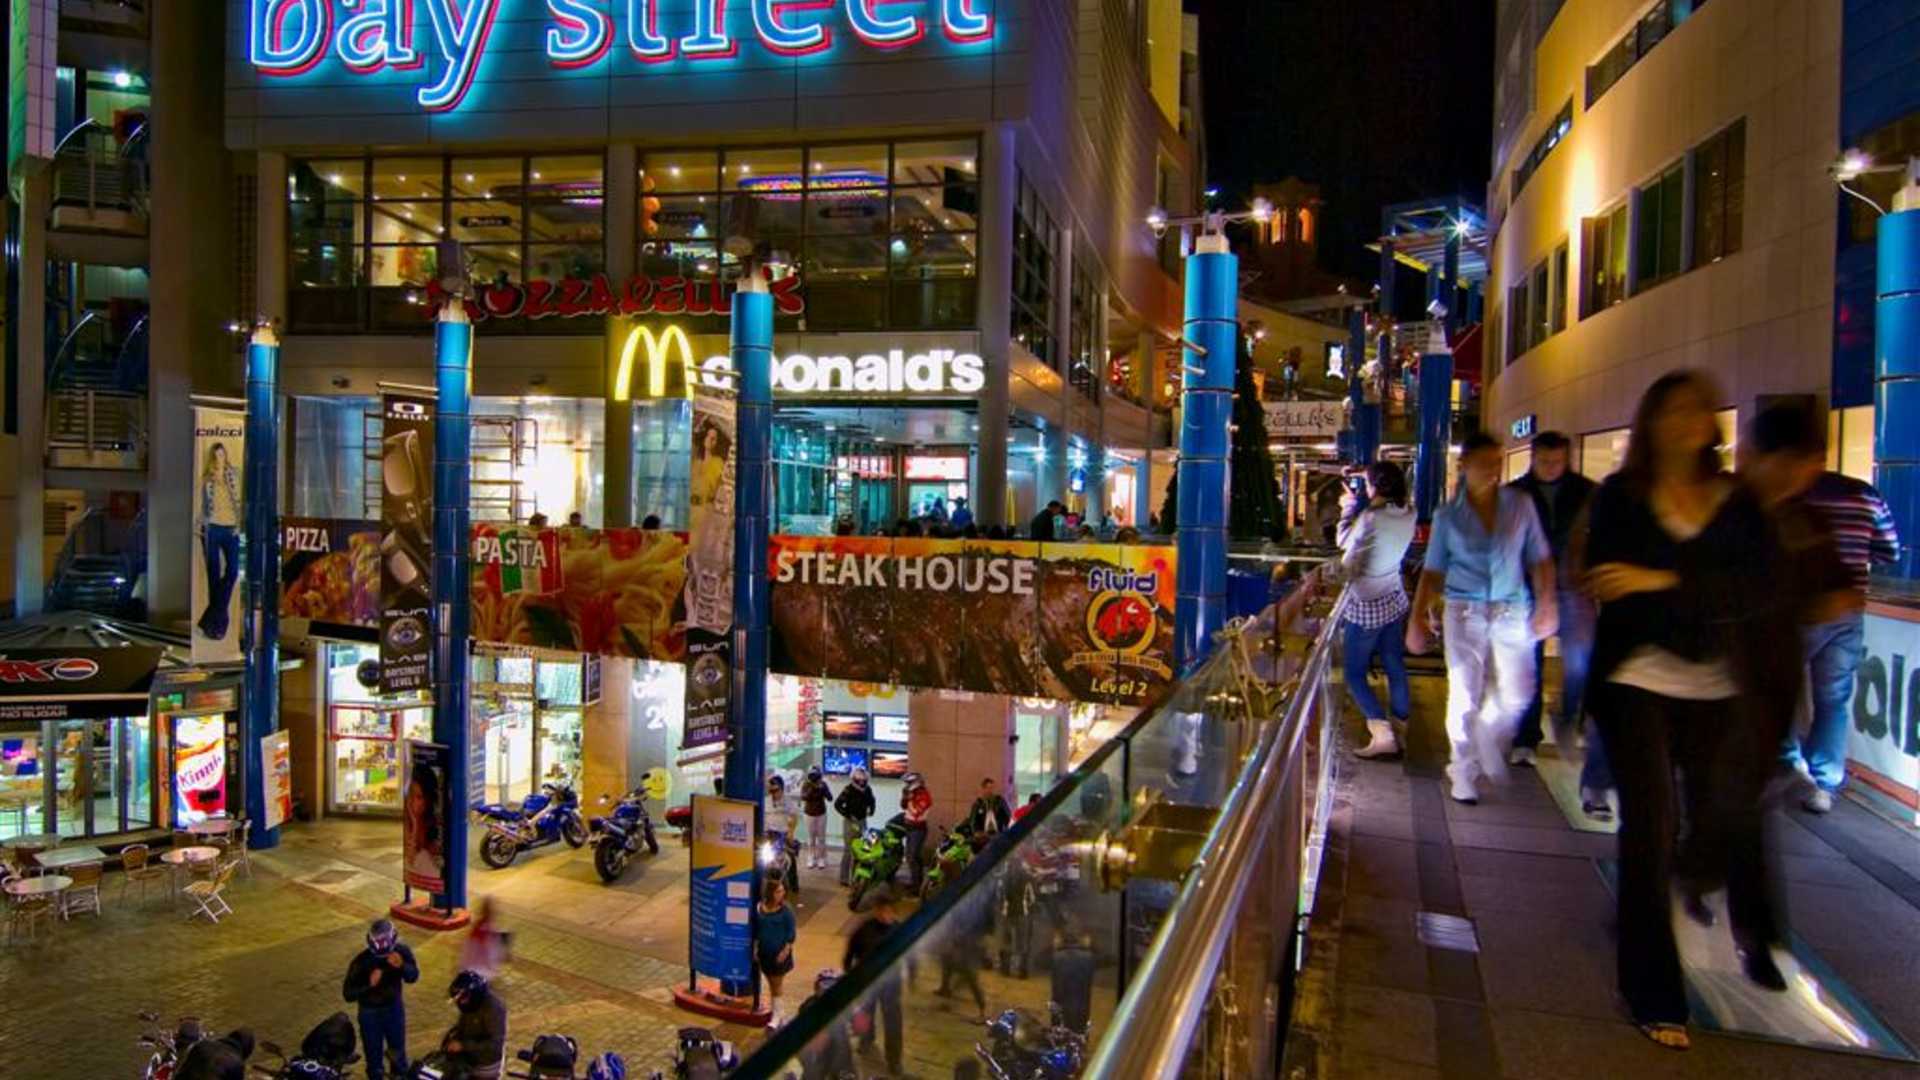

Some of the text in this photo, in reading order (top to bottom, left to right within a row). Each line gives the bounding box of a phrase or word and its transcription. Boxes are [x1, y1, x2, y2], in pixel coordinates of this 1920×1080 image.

[249, 0, 498, 112] bay
[614, 325, 985, 401] Mconald's
[194, 425, 244, 438] colcci
[286, 526, 330, 552] PIZZA
[475, 536, 548, 568] PASTA
[776, 550, 1035, 595] STEAK HOUSE
[1090, 678, 1148, 697] Level 2
